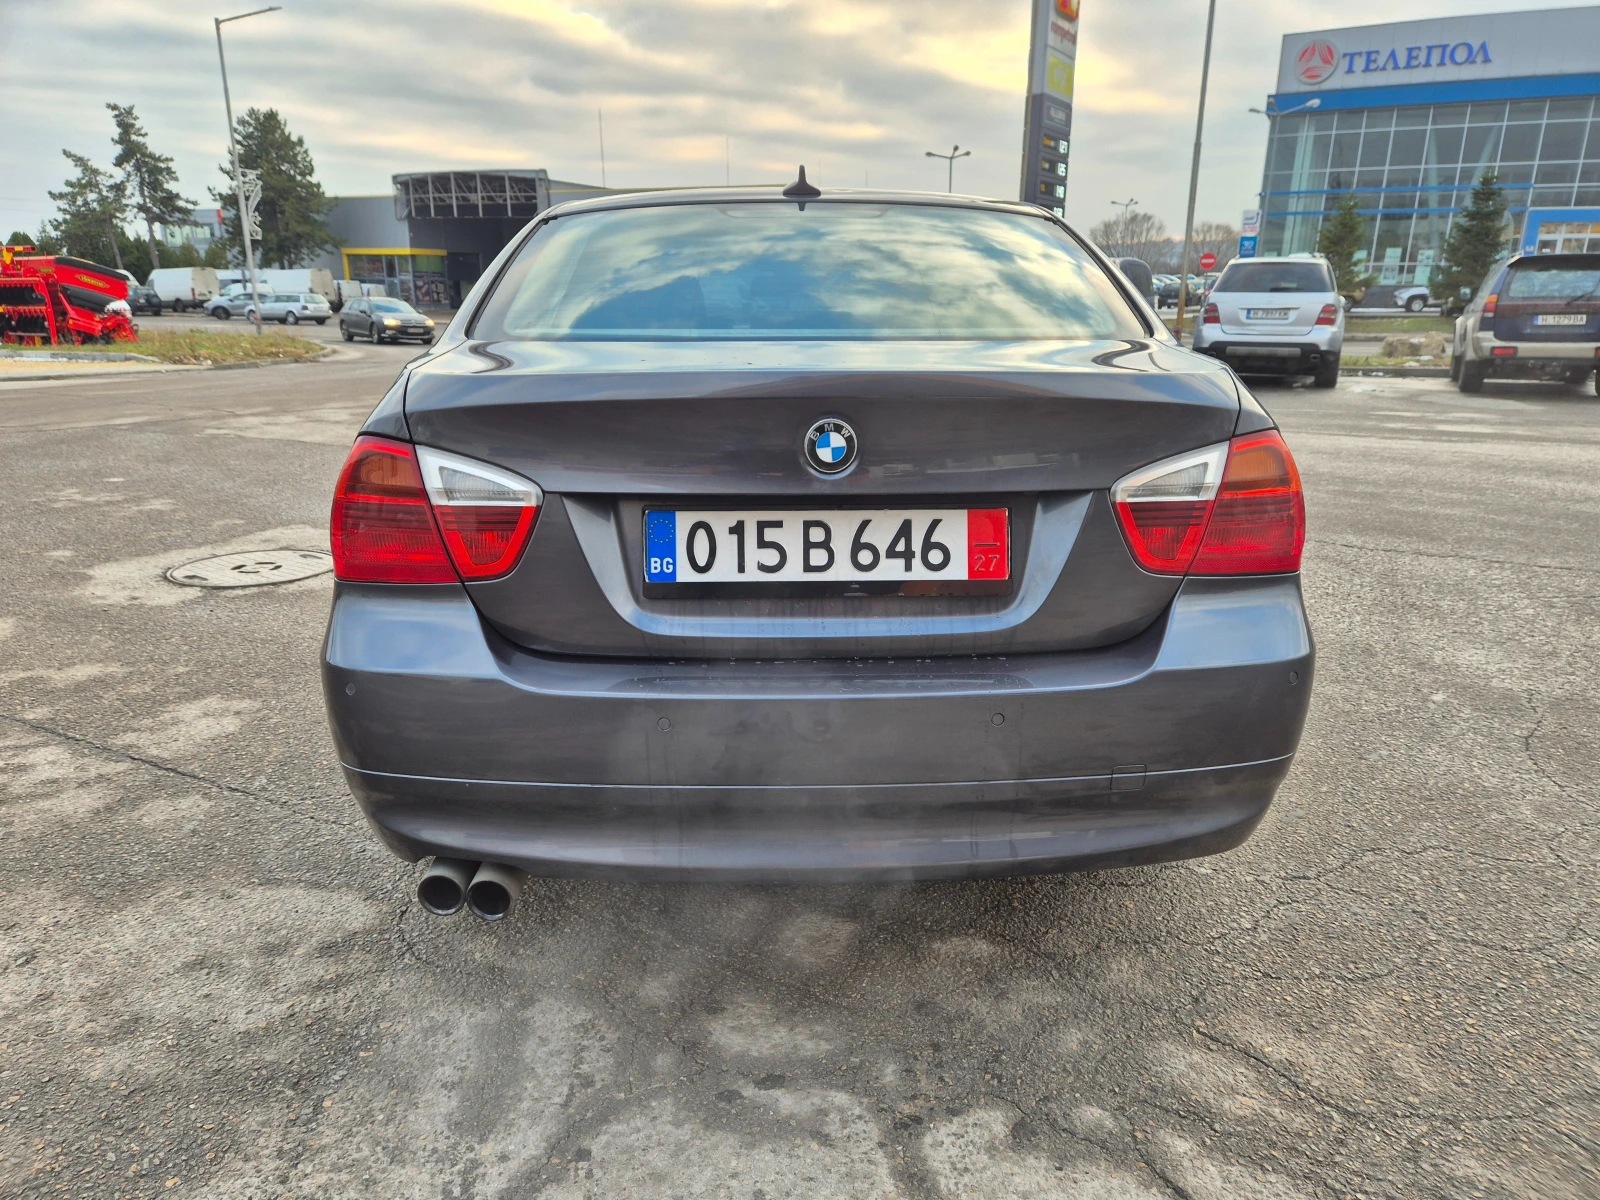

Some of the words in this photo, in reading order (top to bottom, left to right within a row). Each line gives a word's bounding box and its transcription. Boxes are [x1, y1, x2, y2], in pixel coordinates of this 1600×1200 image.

[1342, 40, 1492, 74] ТЕЛЕПОЛ
[810, 423, 851, 441] BMW
[650, 557, 674, 574] BG
[974, 554, 999, 572] 27
